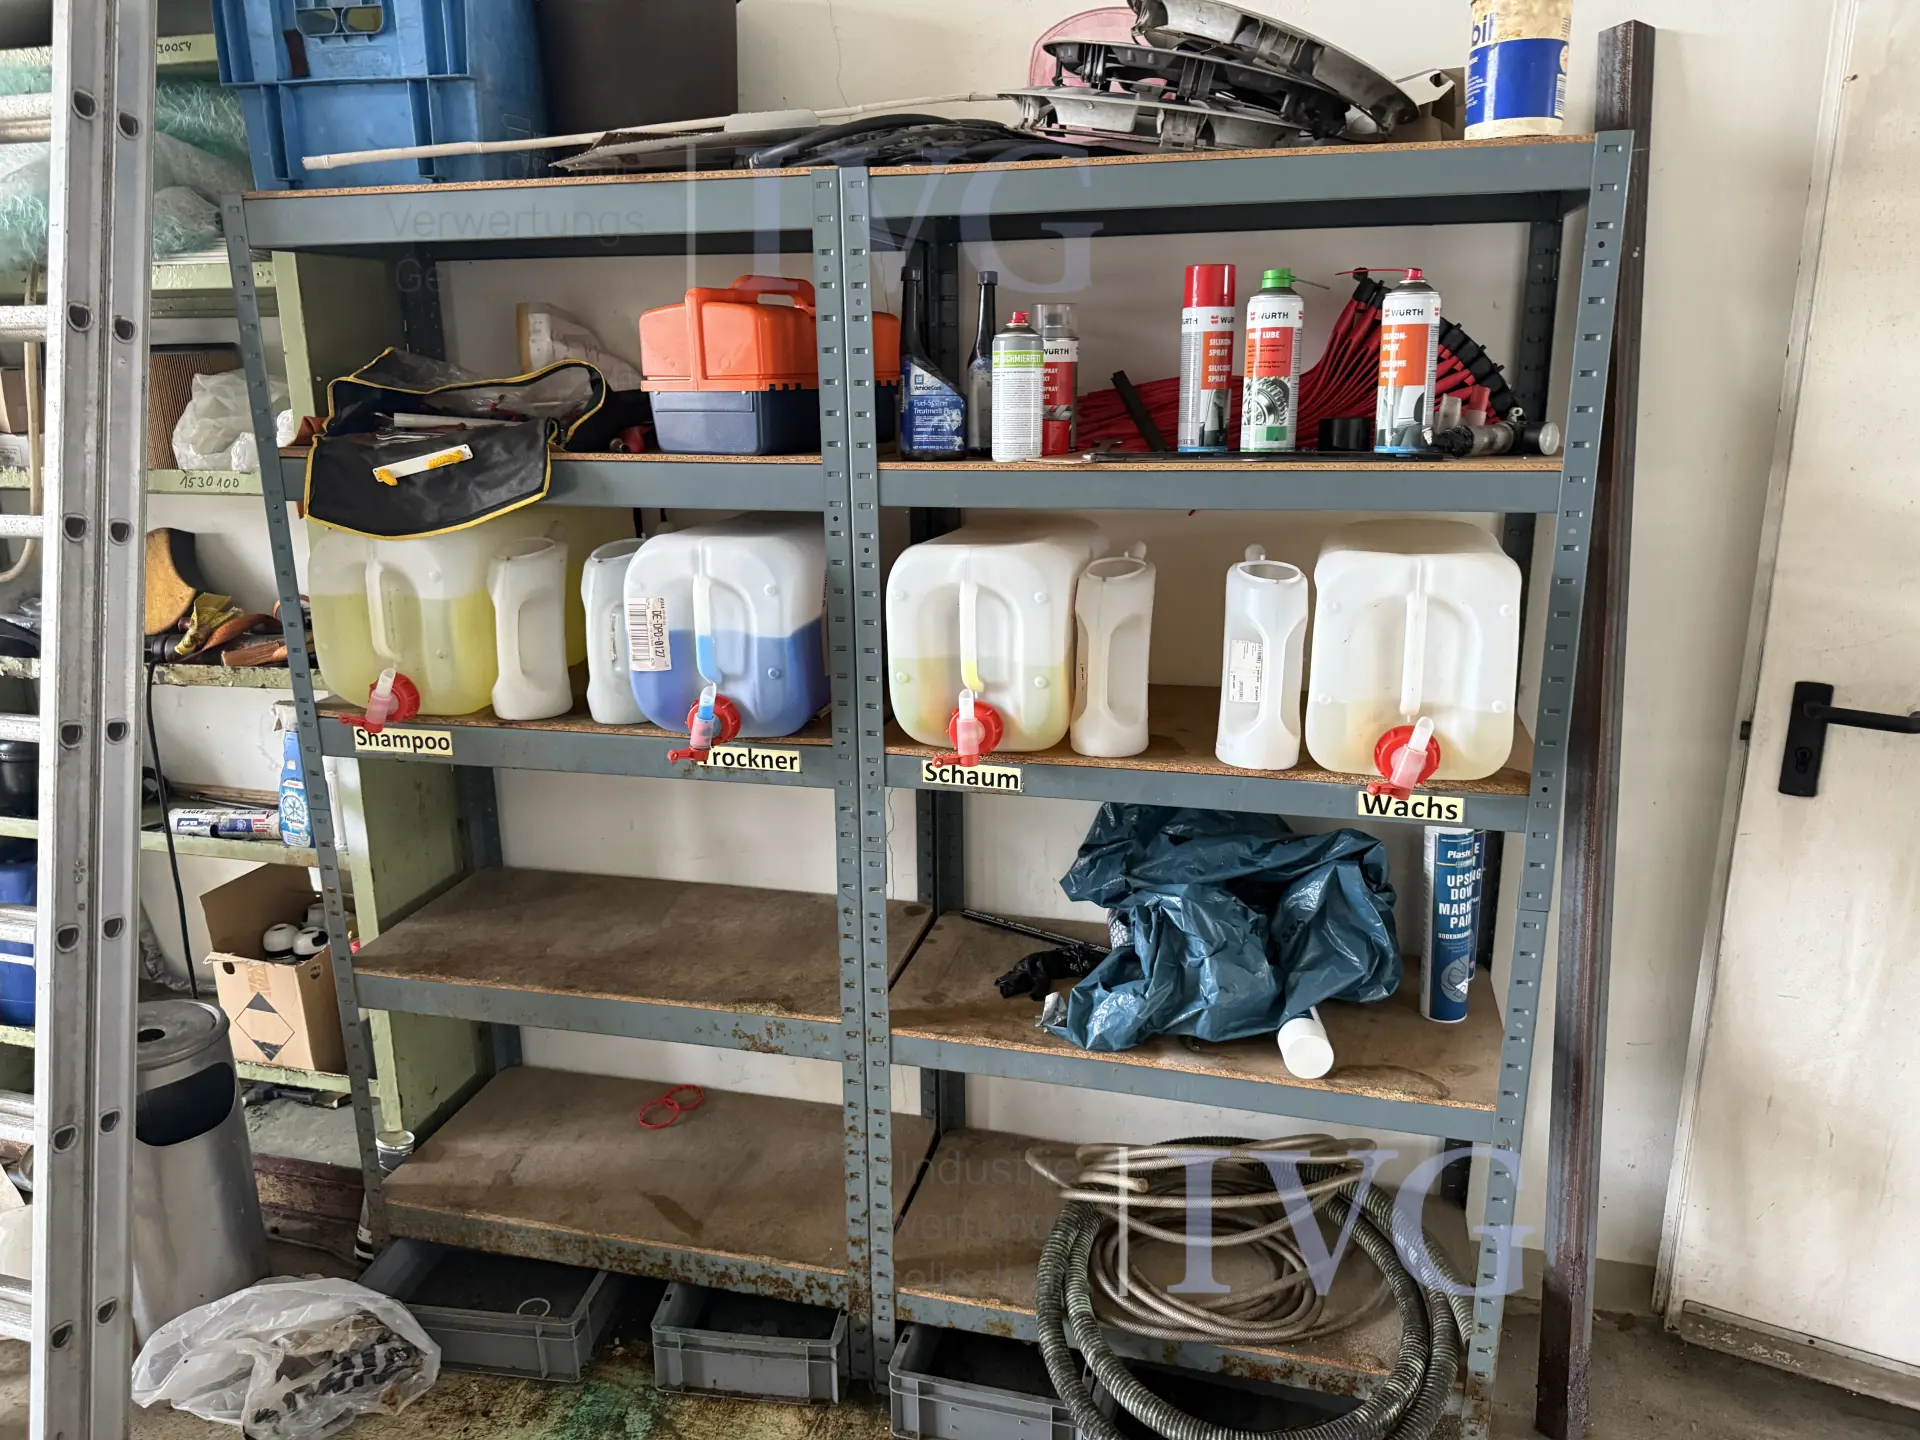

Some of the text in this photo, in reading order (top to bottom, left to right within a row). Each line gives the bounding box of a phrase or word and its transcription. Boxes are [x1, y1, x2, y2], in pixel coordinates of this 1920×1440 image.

[1262, 330, 1281, 339] LUBE
[1208, 349, 1228, 357] SPRAY
[651, 610, 666, 658] DE-DPD-0127
[355, 728, 451, 753] Shampoo
[704, 747, 798, 770] rockner
[924, 762, 1019, 789] Schaum
[1362, 793, 1458, 820] Wachs
